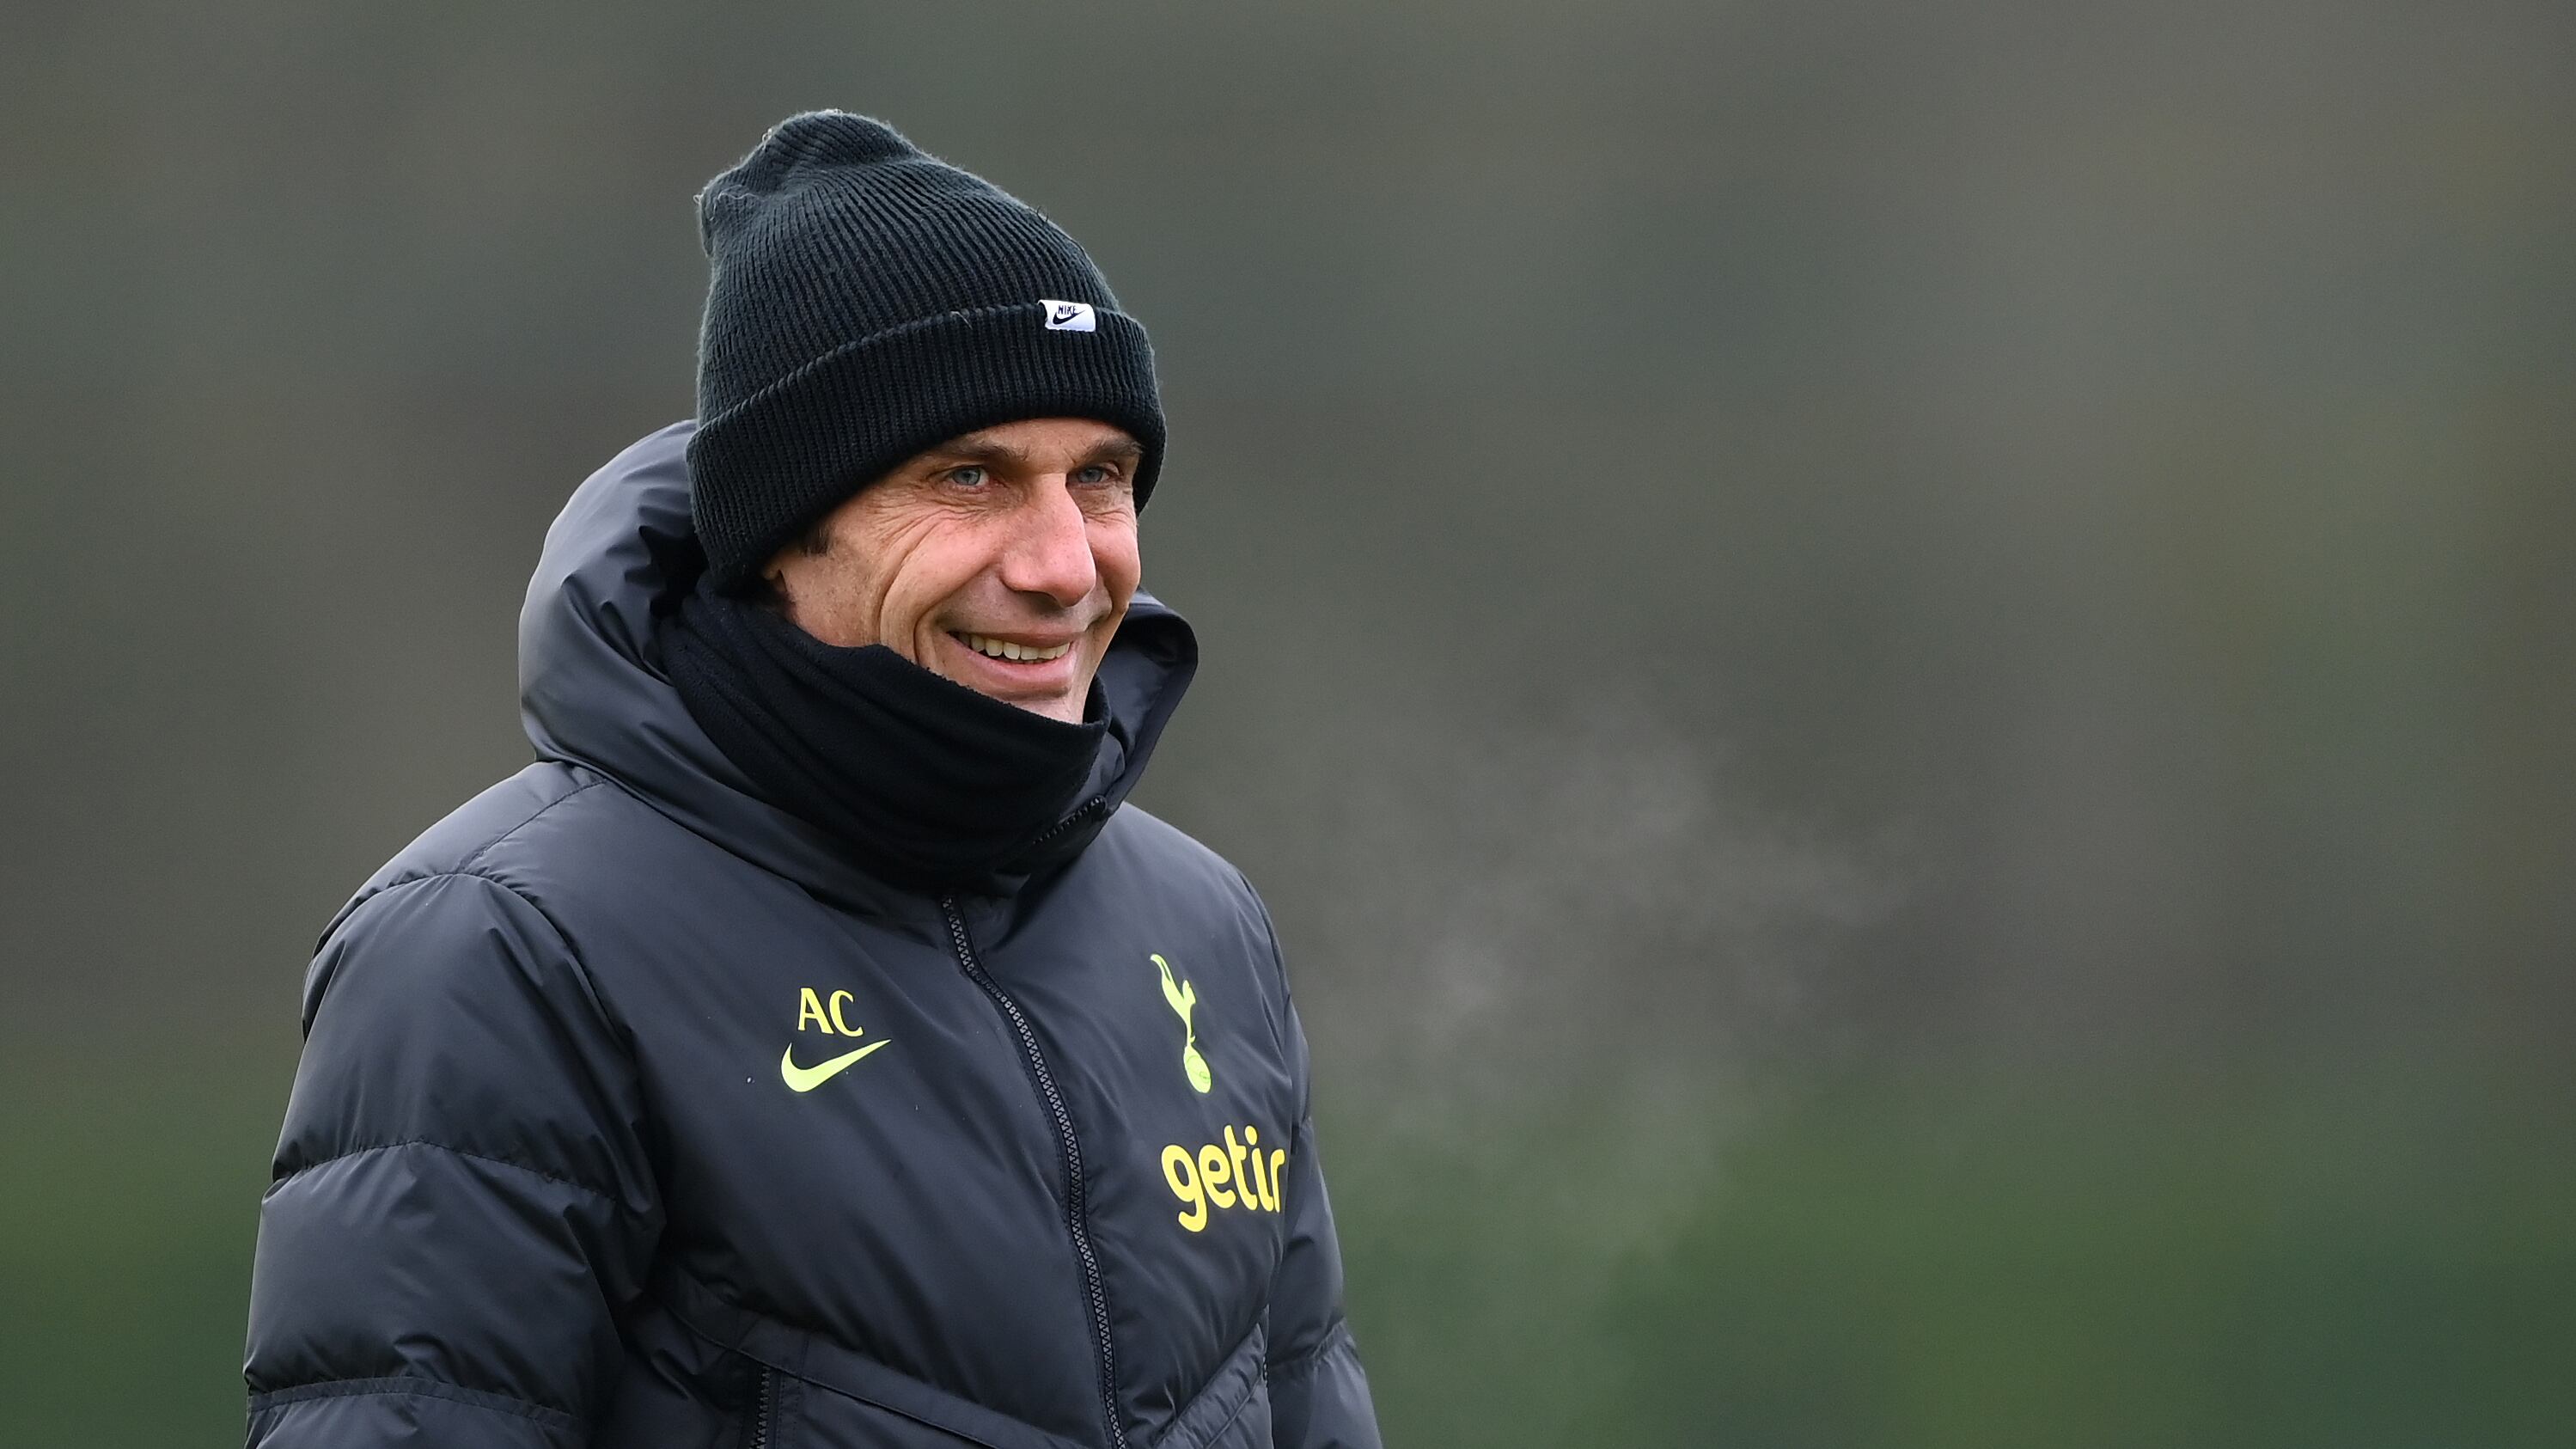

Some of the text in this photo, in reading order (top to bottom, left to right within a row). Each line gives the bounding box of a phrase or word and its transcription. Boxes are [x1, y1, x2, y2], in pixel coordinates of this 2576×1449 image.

[1058, 304, 1077, 315] NIKE
[797, 987, 864, 1037] AC
[1161, 1124, 1285, 1232] getir
